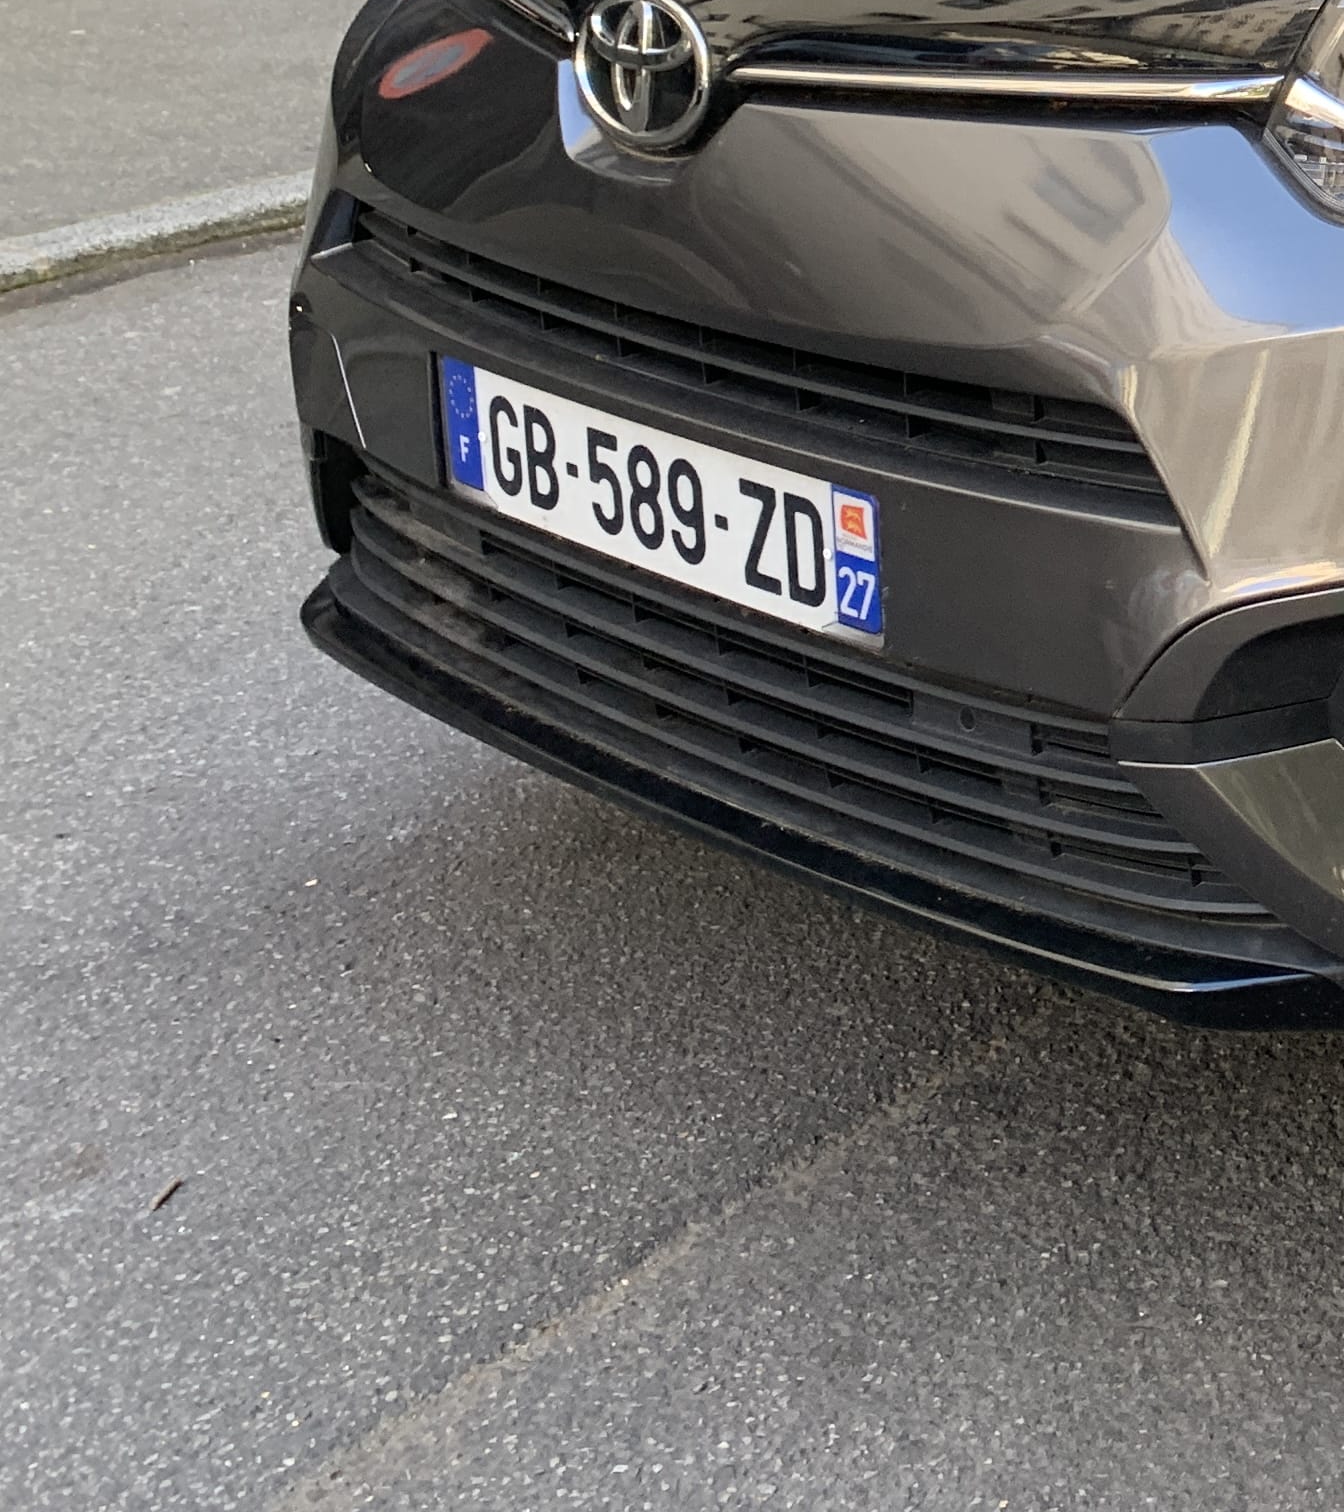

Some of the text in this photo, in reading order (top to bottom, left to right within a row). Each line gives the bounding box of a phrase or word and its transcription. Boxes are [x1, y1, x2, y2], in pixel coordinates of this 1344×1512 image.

[459, 434, 470, 462] F
[489, 395, 827, 608] GB-589-ZD
[838, 566, 876, 620] 27
